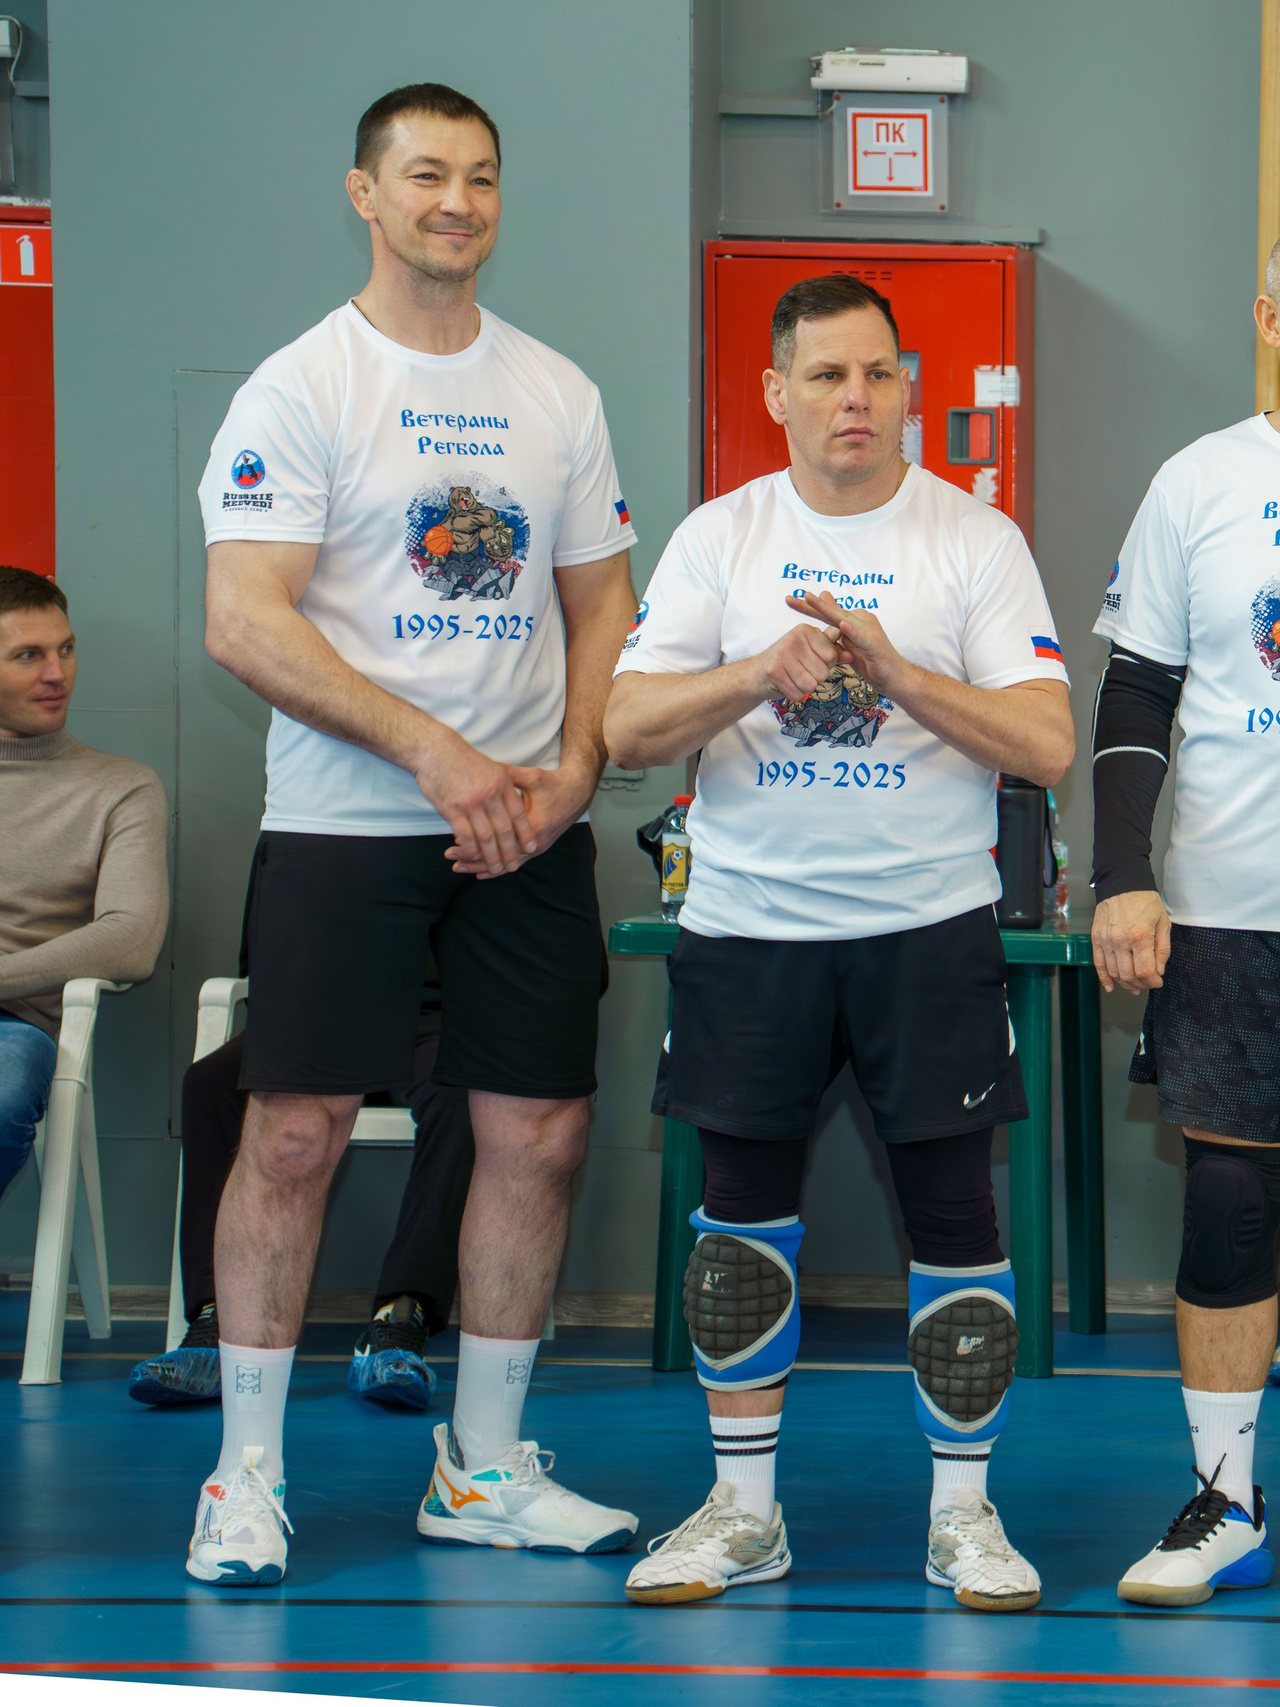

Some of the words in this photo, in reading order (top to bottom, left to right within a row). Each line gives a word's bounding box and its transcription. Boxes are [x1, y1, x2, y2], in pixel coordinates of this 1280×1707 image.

[875, 122, 905, 143] ПК
[400, 408, 510, 433] Ветераны
[417, 436, 505, 456] Регбола
[222, 500, 273, 509] MEDVEDI
[223, 492, 273, 501] RUSSKIE
[780, 563, 895, 587] Ветераны
[392, 614, 534, 641] 1995-2025
[755, 760, 906, 789] 1995-2025
